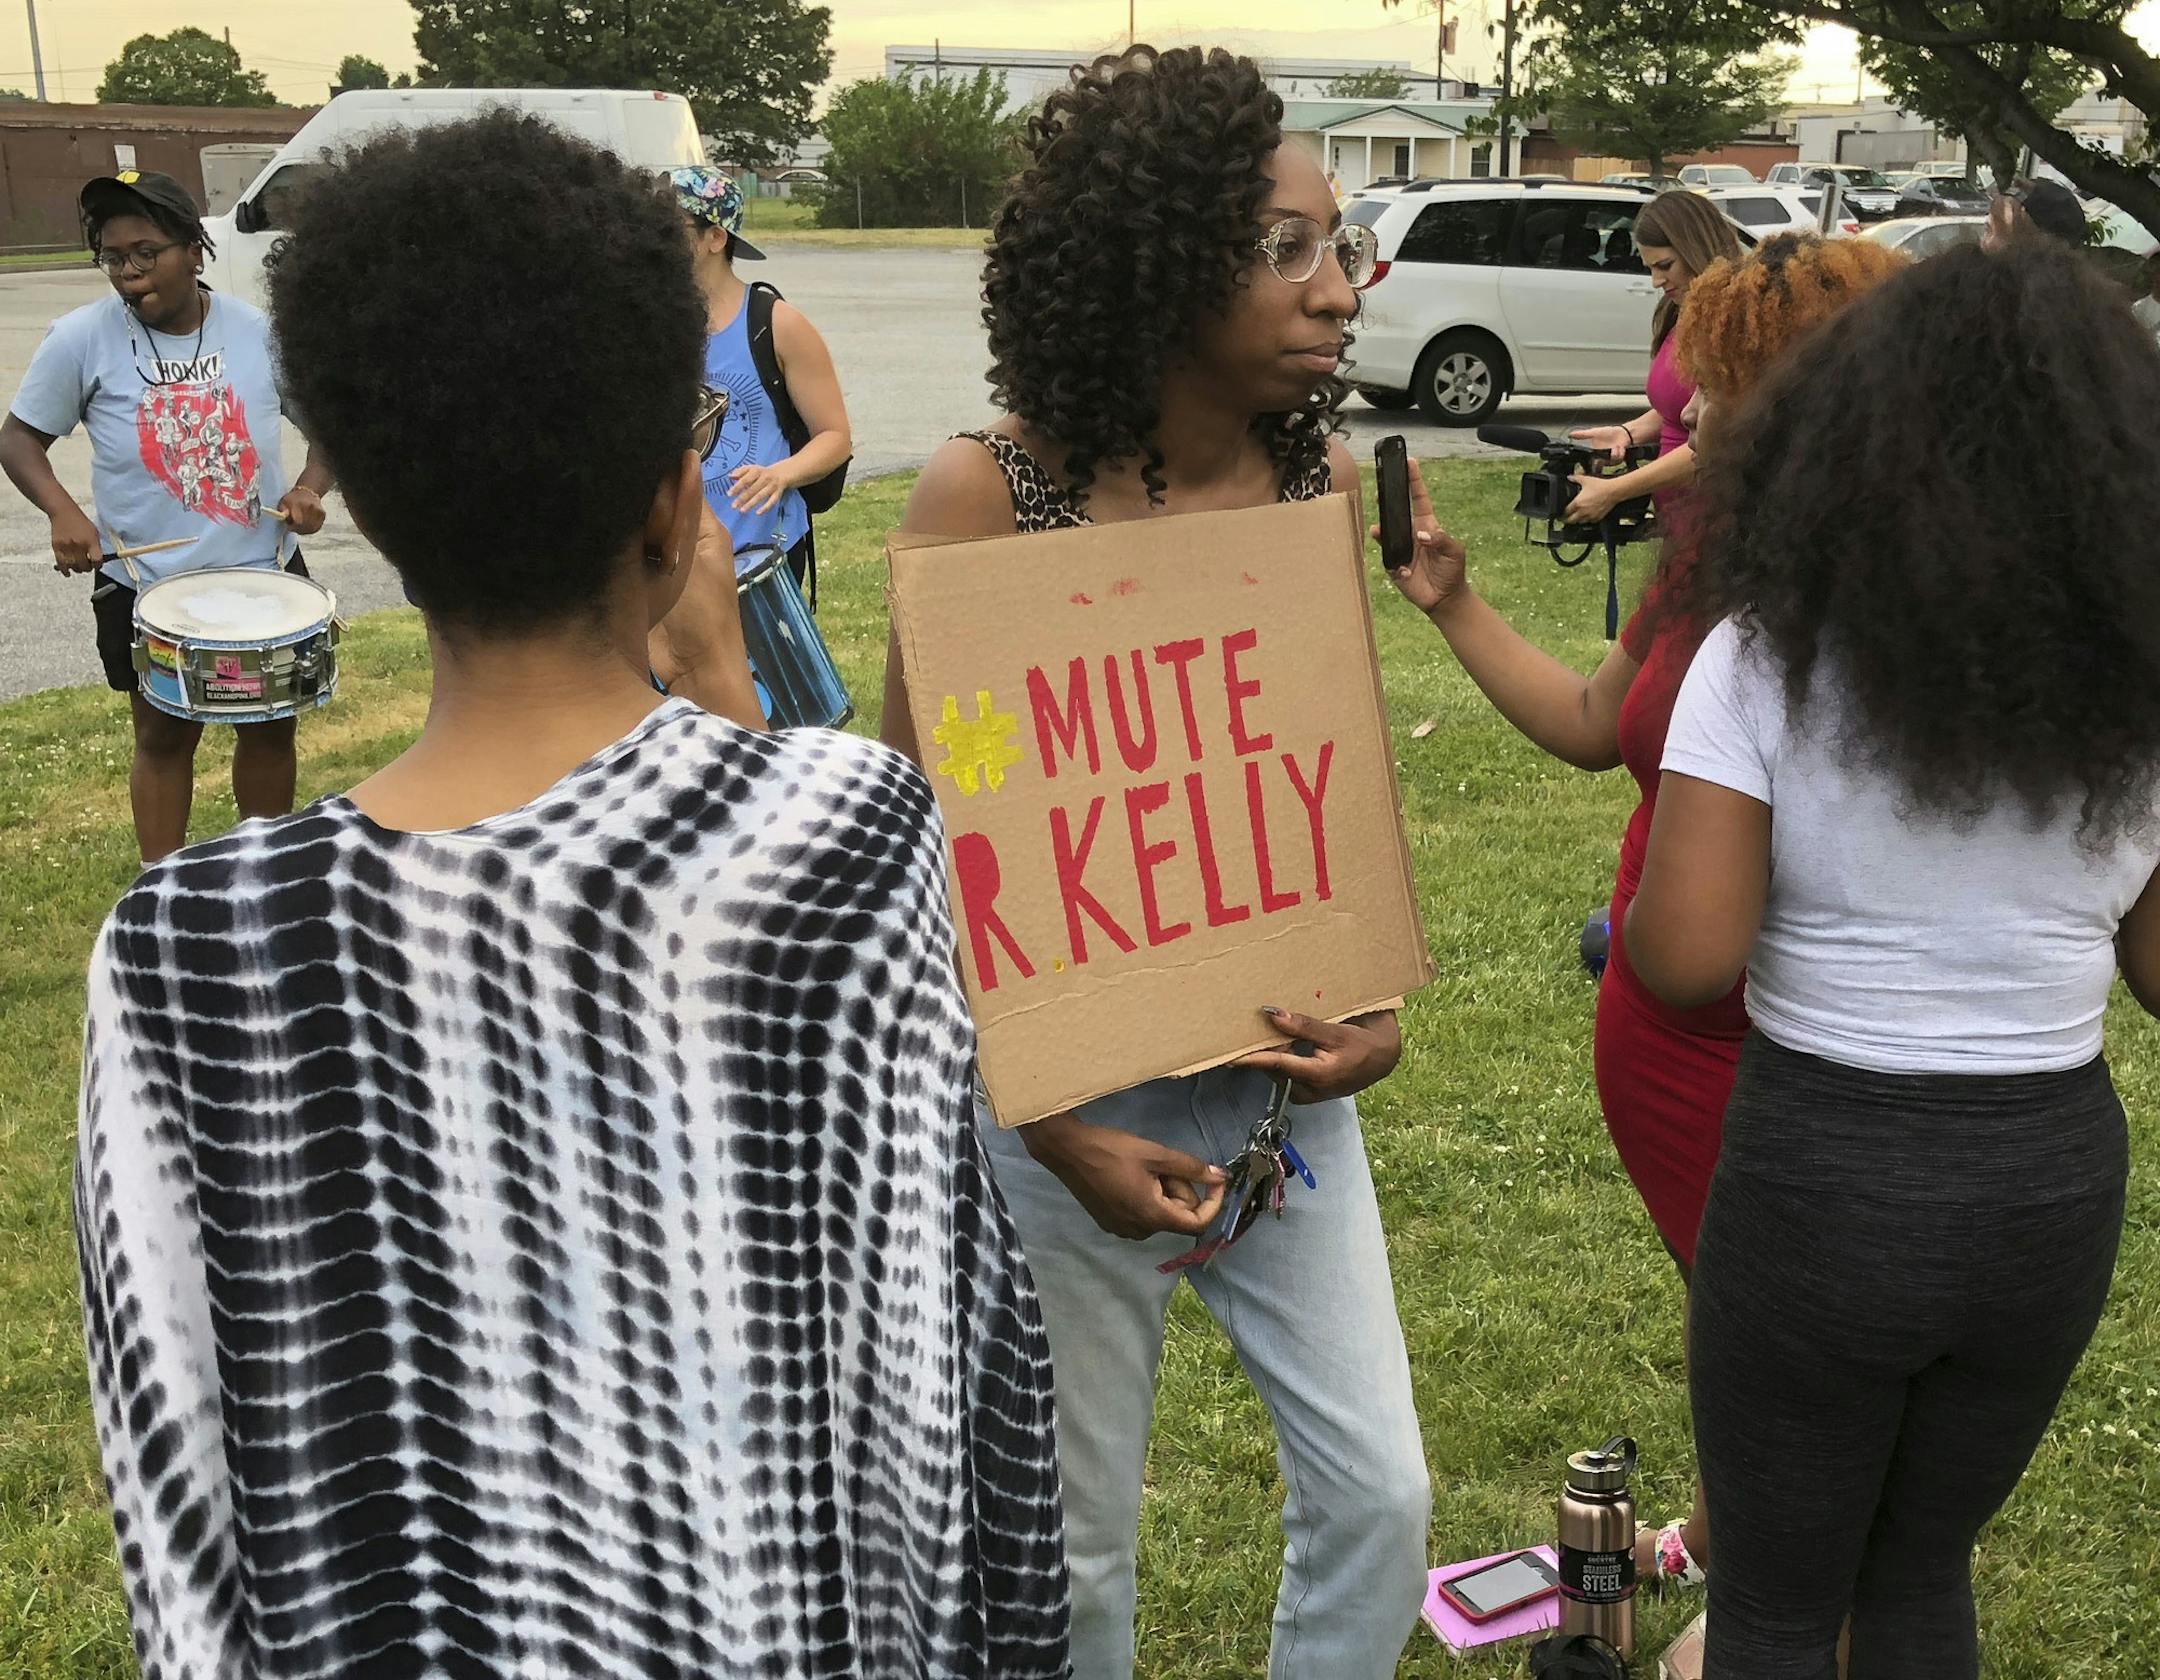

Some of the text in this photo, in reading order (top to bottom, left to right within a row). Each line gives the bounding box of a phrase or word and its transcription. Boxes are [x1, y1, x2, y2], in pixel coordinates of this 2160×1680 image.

[155, 355, 218, 382] HONK!
[932, 628, 1273, 796] #MUTE
[952, 741, 1334, 992] R KELLY
[1582, 1564, 1622, 1575] STAINLESS
[1582, 1574, 1622, 1592] STEEL
